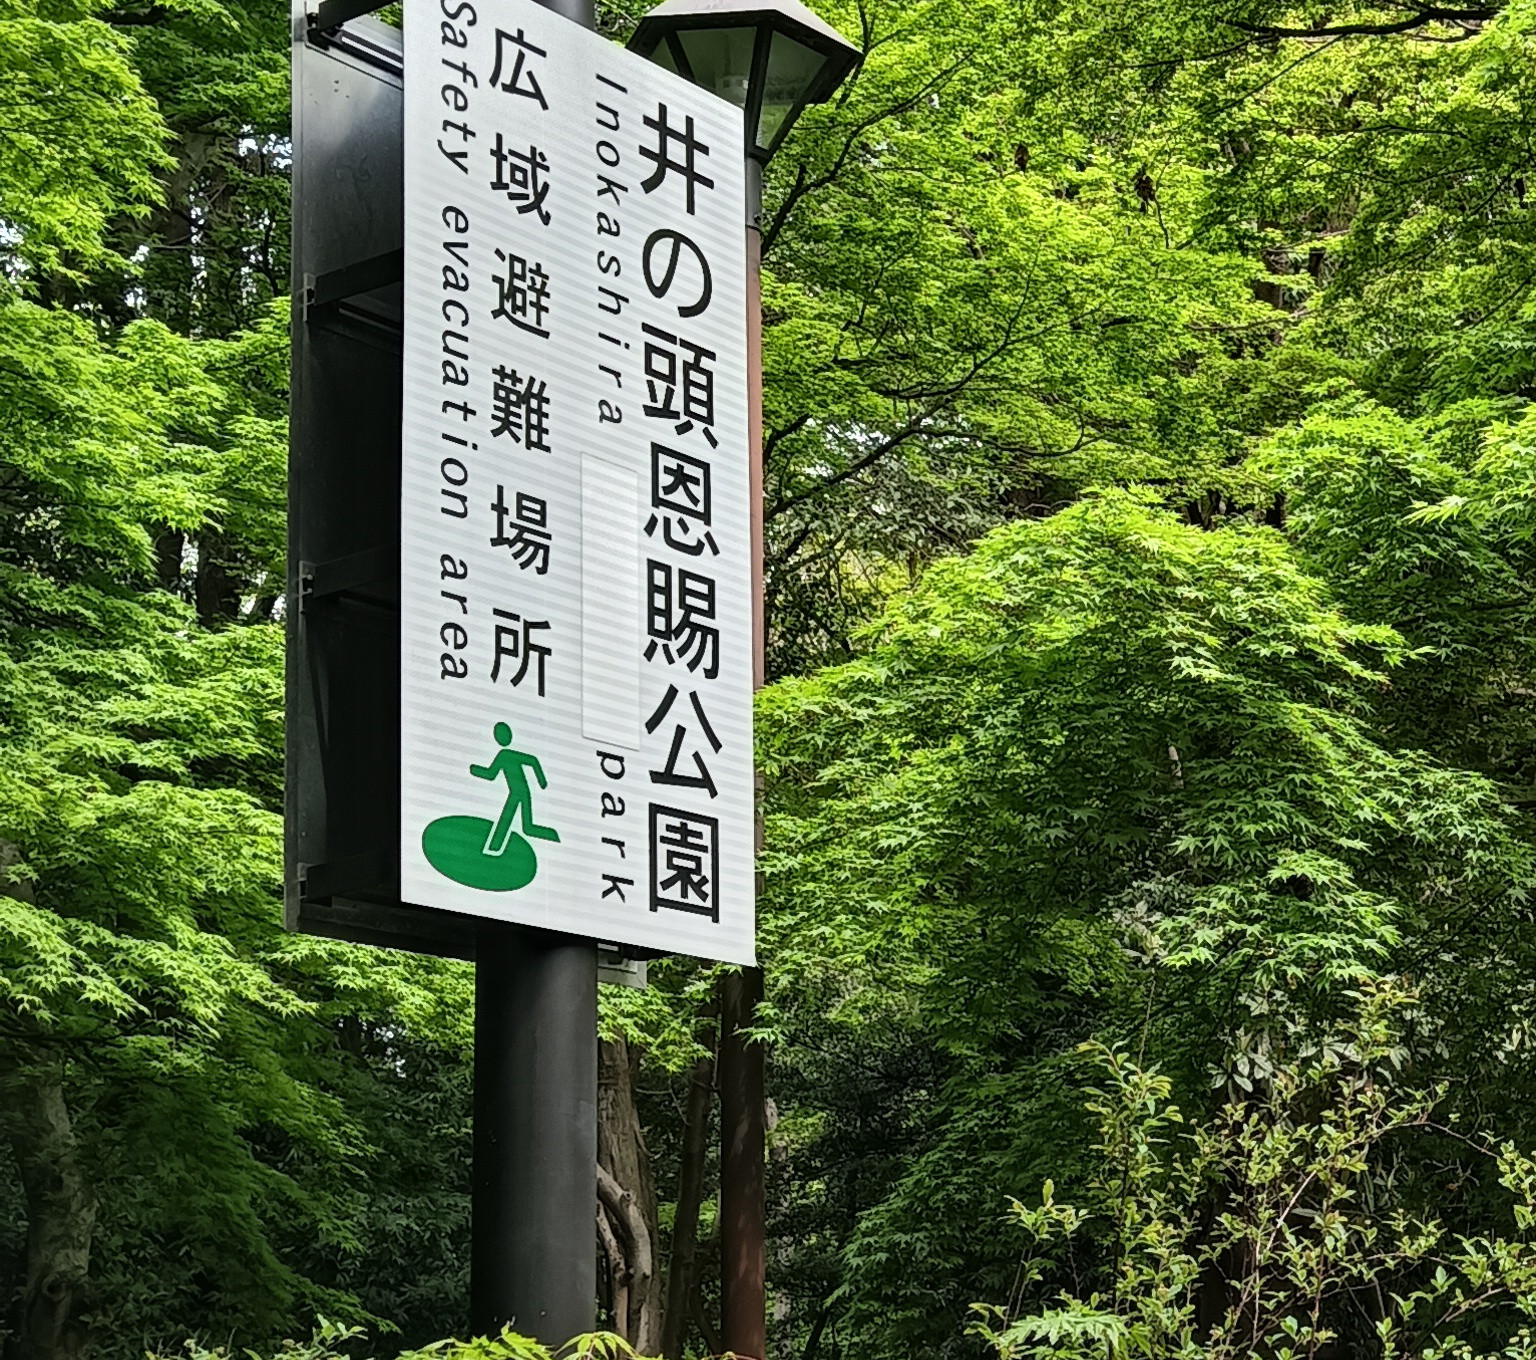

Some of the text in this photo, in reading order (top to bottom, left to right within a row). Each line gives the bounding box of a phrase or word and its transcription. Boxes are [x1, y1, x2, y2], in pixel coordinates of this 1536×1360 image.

[439, 553, 468, 681] area
[440, 205, 479, 519] evacuation
[488, 27, 553, 698] 広域避難場所
[595, 73, 635, 904] Inokashira park
[638, 102, 723, 924] 井の頭恩賜公園
